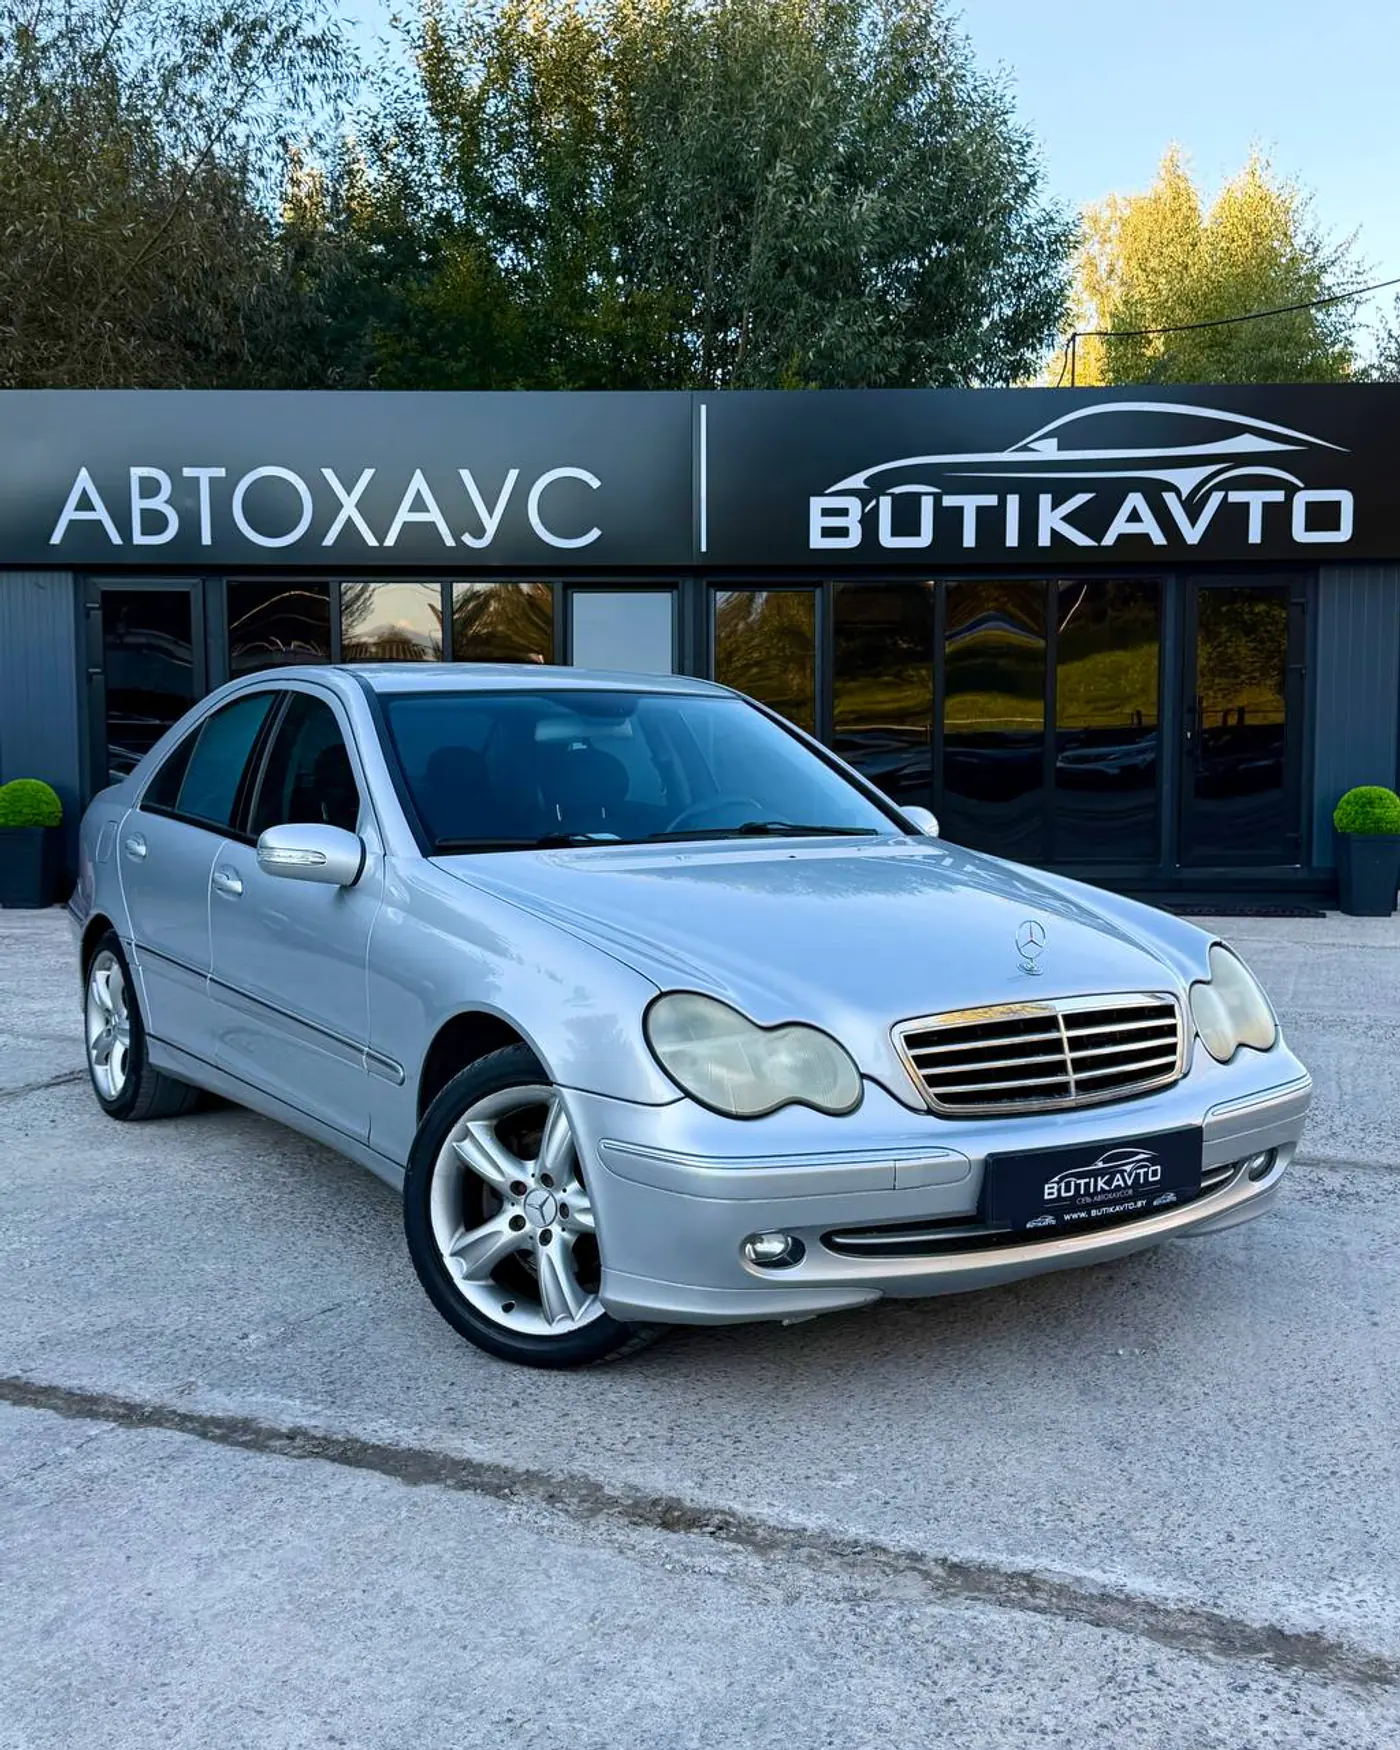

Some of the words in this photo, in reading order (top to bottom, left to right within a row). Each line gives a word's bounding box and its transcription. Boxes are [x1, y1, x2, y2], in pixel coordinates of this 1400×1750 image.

[49, 465, 603, 549] АВТОХАУС
[808, 488, 1354, 550] BUTIKAVTO
[1044, 1165, 1161, 1200] BUTIKAVTO
[1091, 1200, 1147, 1217] BUTIKAVTO.BY
